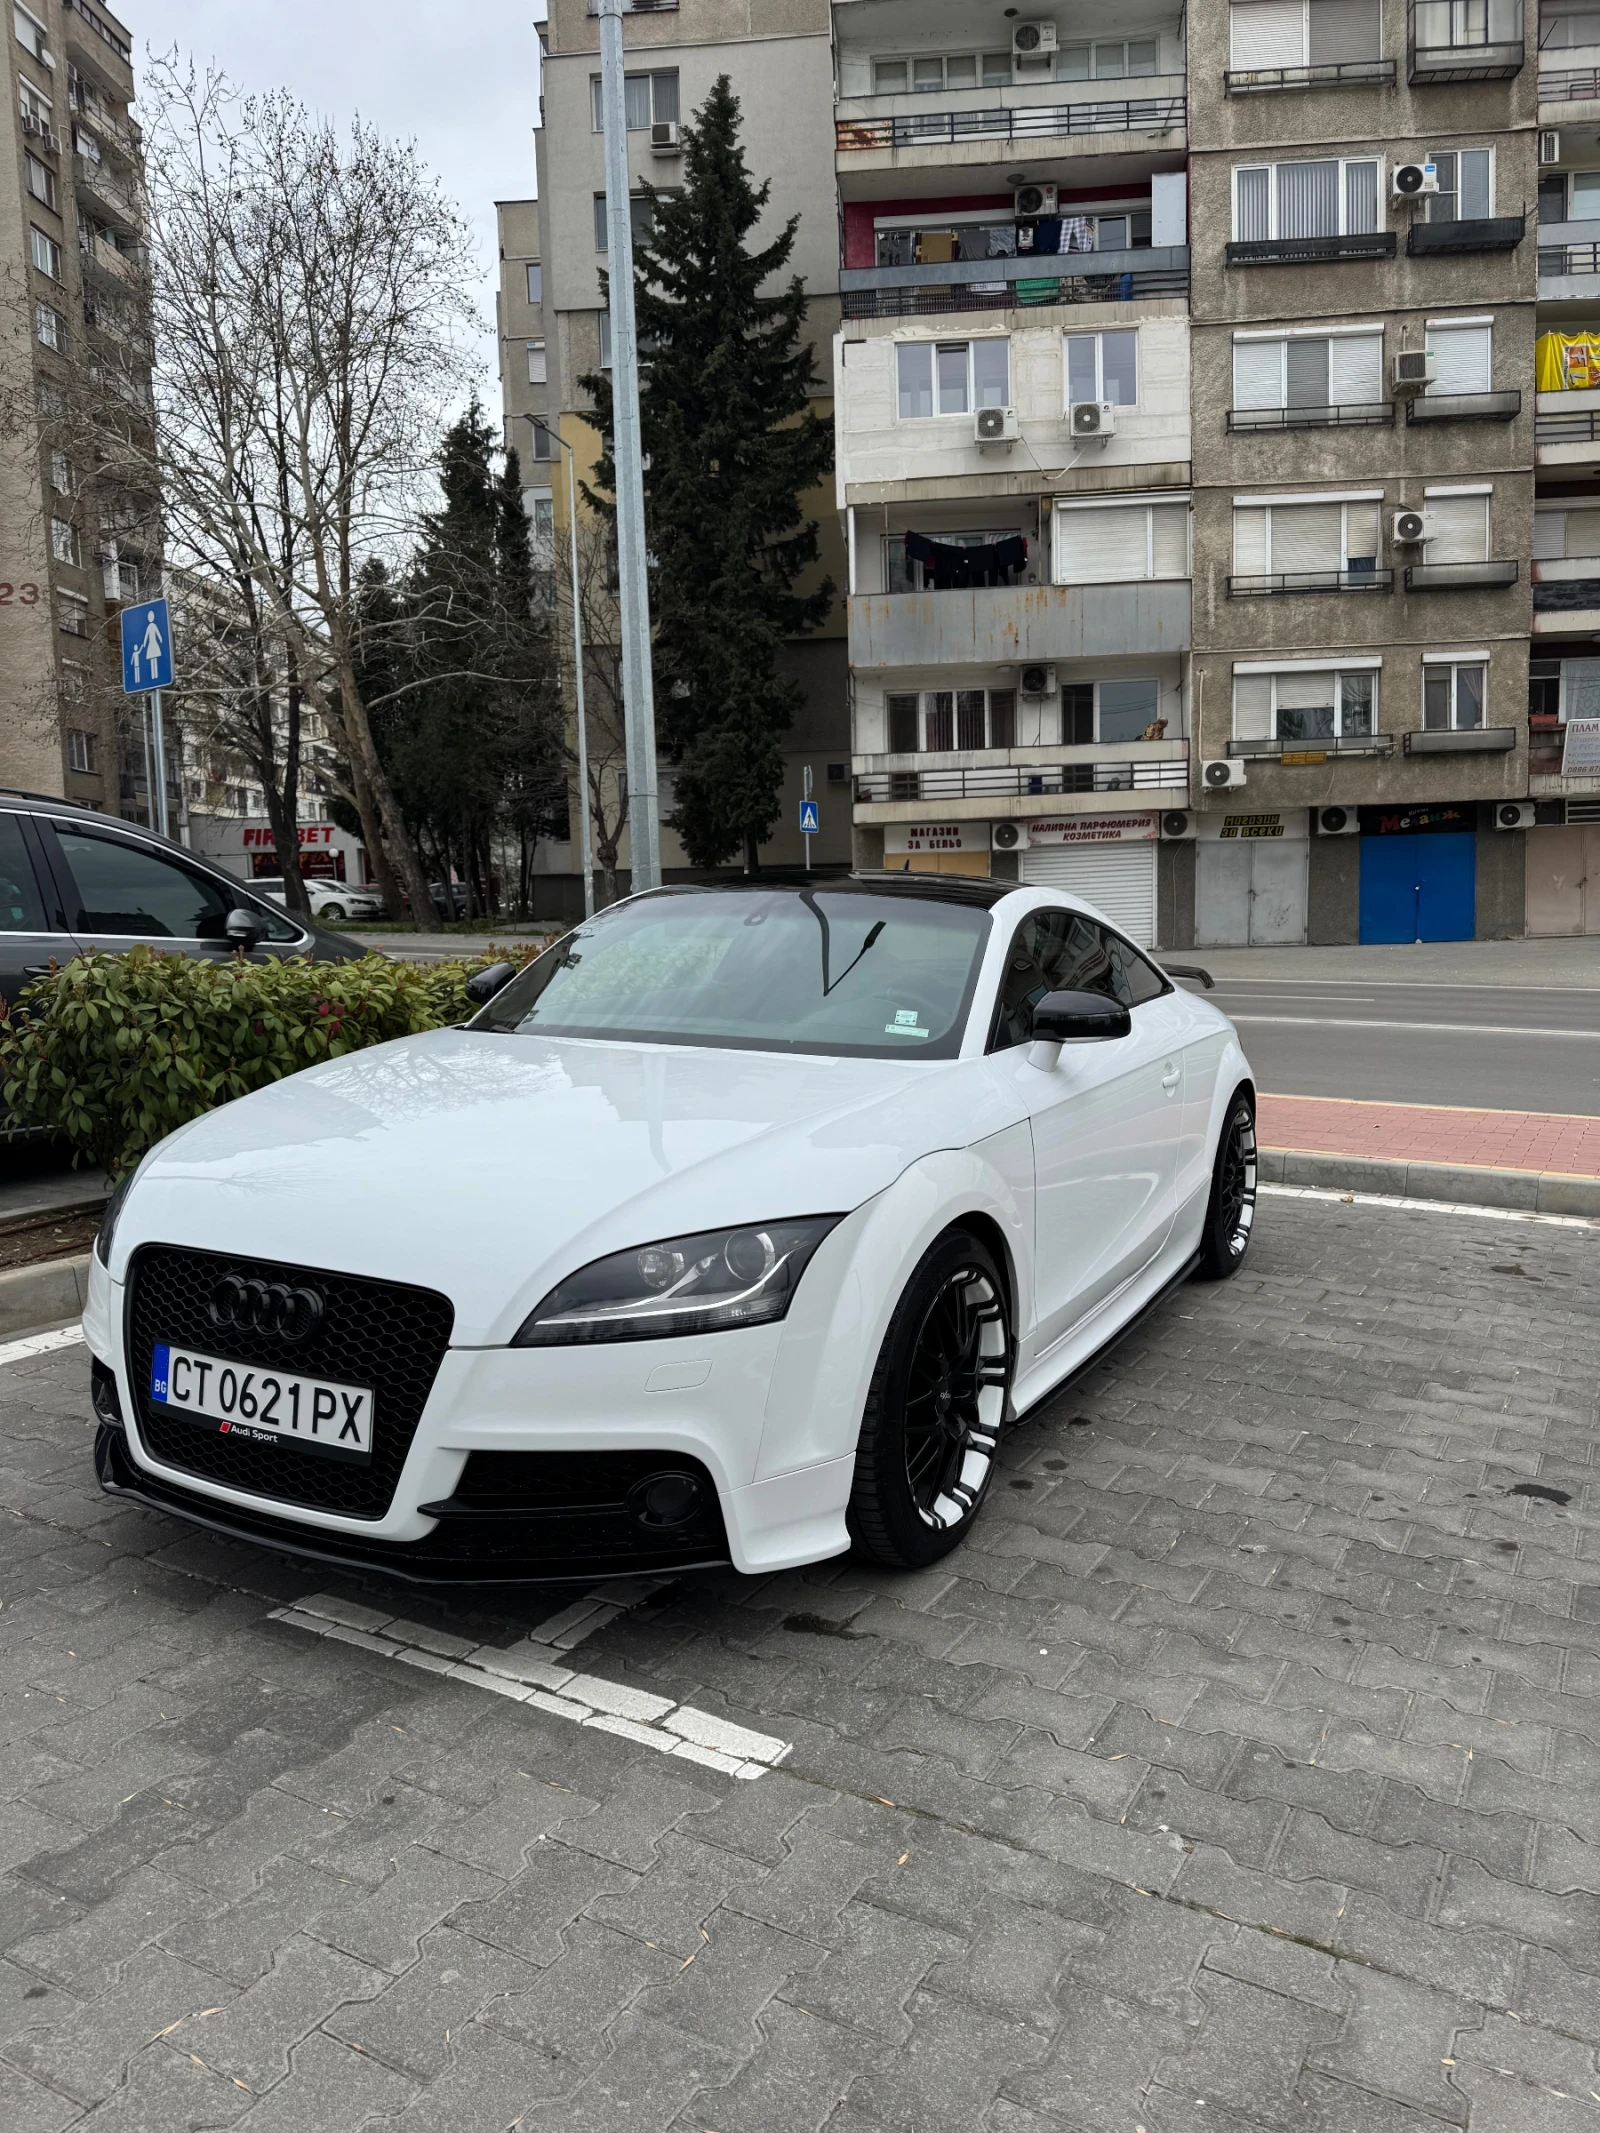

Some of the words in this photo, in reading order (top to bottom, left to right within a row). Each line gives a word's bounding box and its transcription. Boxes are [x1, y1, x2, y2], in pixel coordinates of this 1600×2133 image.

[910, 827, 959, 837] МАГАЗИН
[1032, 822, 1077, 833] НАЛИВНА
[1080, 818, 1151, 831] ПАРФЮМЕРИЯ
[1063, 830, 1121, 841] КОЗМЕТИКА
[908, 840, 921, 849] ЗА
[929, 839, 962, 849] БЕЛЬО
[154, 1379, 167, 1394] BG
[172, 1356, 213, 1407] CT
[219, 1368, 300, 1430] 0621
[312, 1387, 365, 1443] PX
[231, 1424, 250, 1437] Audi
[252, 1429, 278, 1443] Sport
